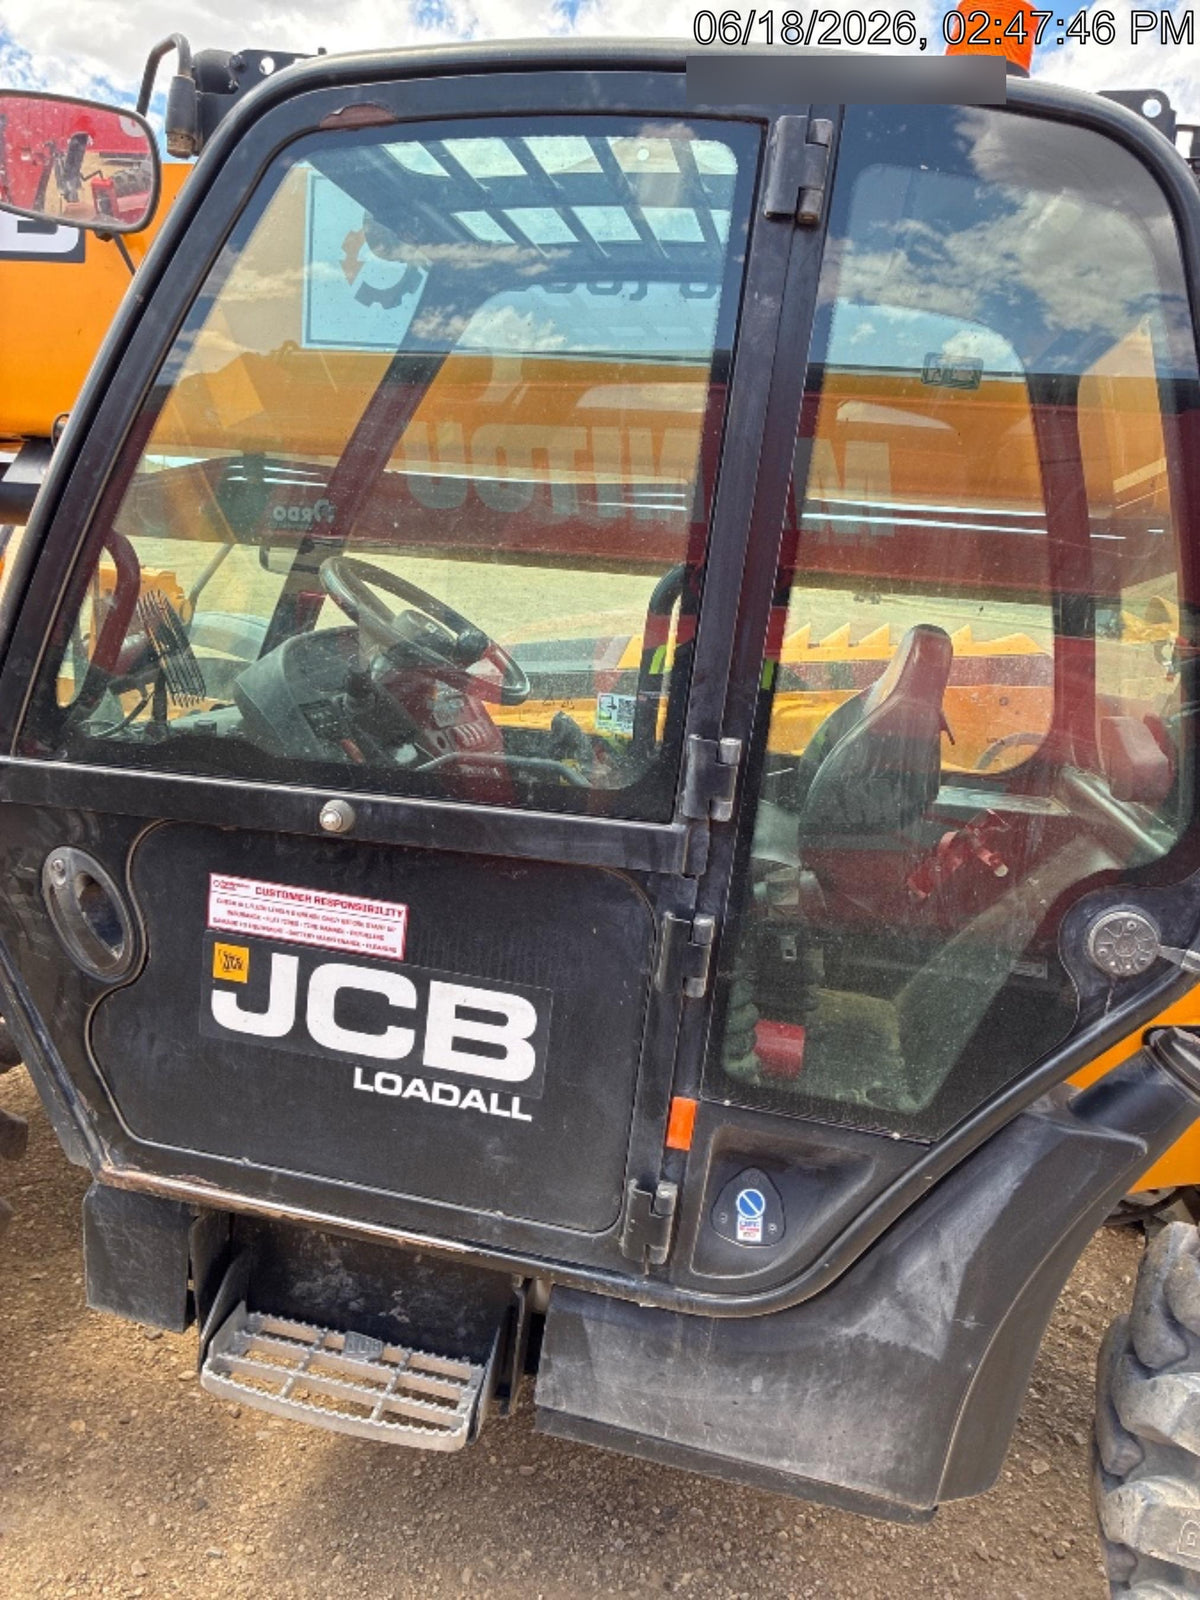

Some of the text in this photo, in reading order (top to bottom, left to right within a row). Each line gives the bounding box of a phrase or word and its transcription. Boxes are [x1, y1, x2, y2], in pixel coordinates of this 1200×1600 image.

[255, 885, 312, 907] CUSTOMER
[313, 895, 404, 919] RESPONSIBILITY
[210, 951, 538, 1083] JCB
[353, 1066, 533, 1122] LOADALL
